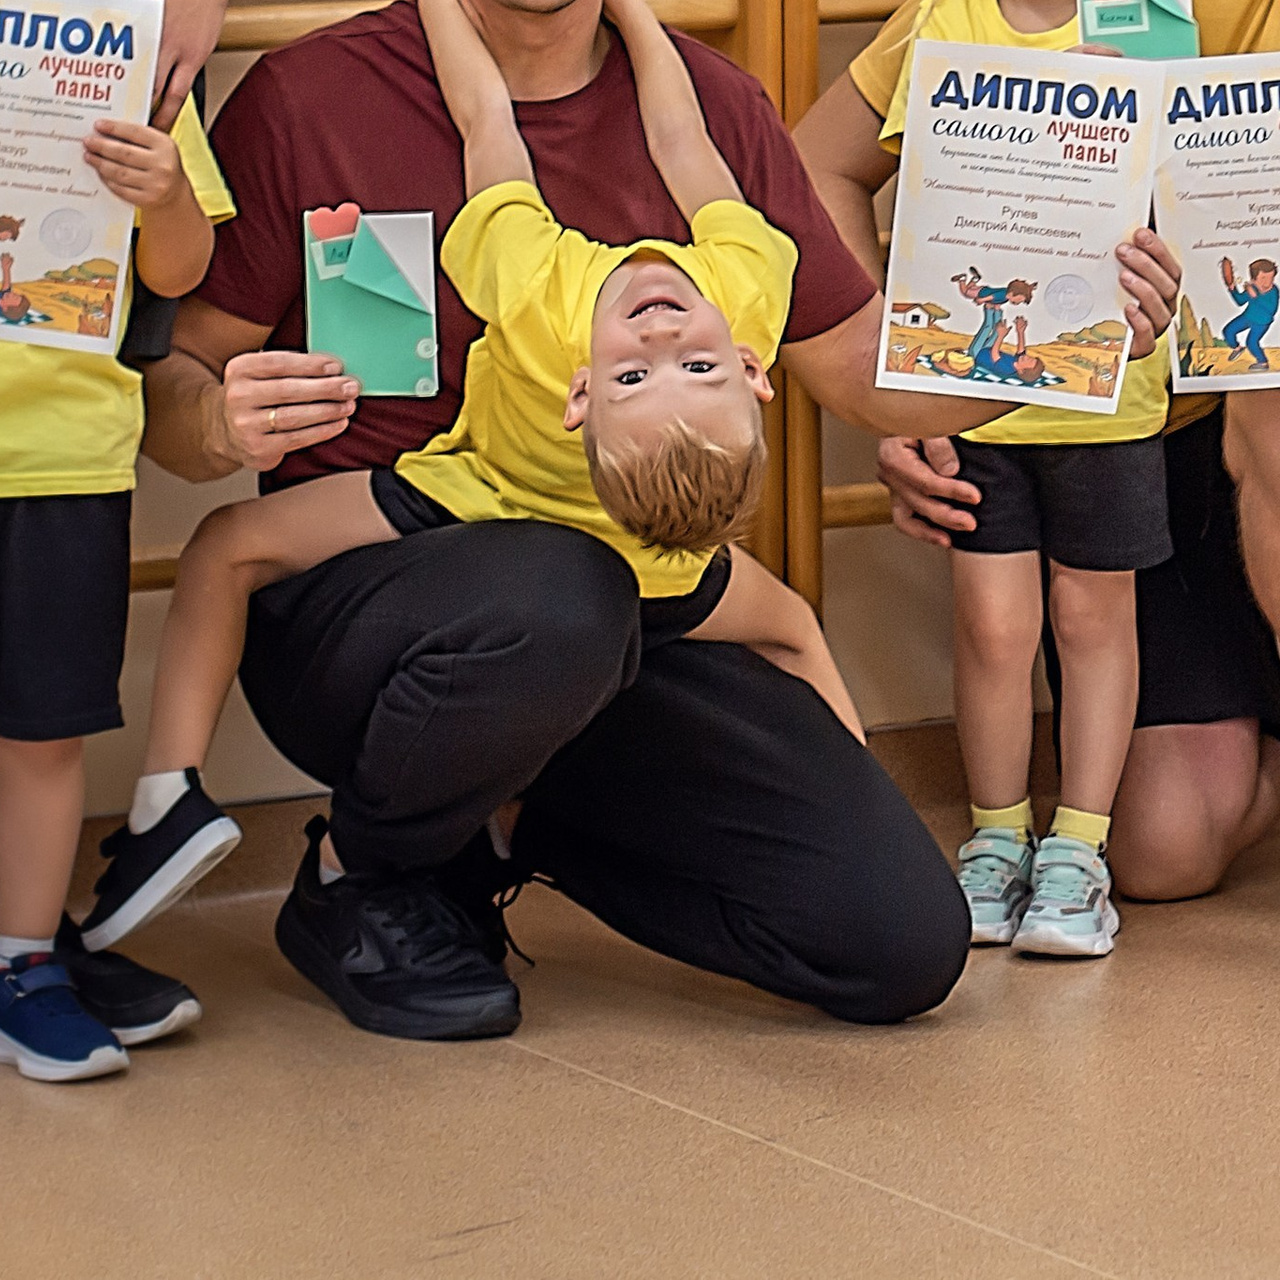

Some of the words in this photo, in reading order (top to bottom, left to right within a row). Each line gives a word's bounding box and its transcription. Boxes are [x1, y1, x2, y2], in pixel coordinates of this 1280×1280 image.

[0, 9, 133, 60] ПЛОМ
[39, 55, 125, 80] лучшего
[56, 80, 111, 101] папы
[932, 70, 1138, 124] ДИПЛОМ
[932, 118, 1040, 145] самого
[1047, 120, 1130, 143] лучшего
[1174, 126, 1274, 151] самого
[1063, 144, 1118, 165] папы
[954, 216, 1007, 232] Дмитрий
[1010, 223, 1081, 239] Алексеевич
